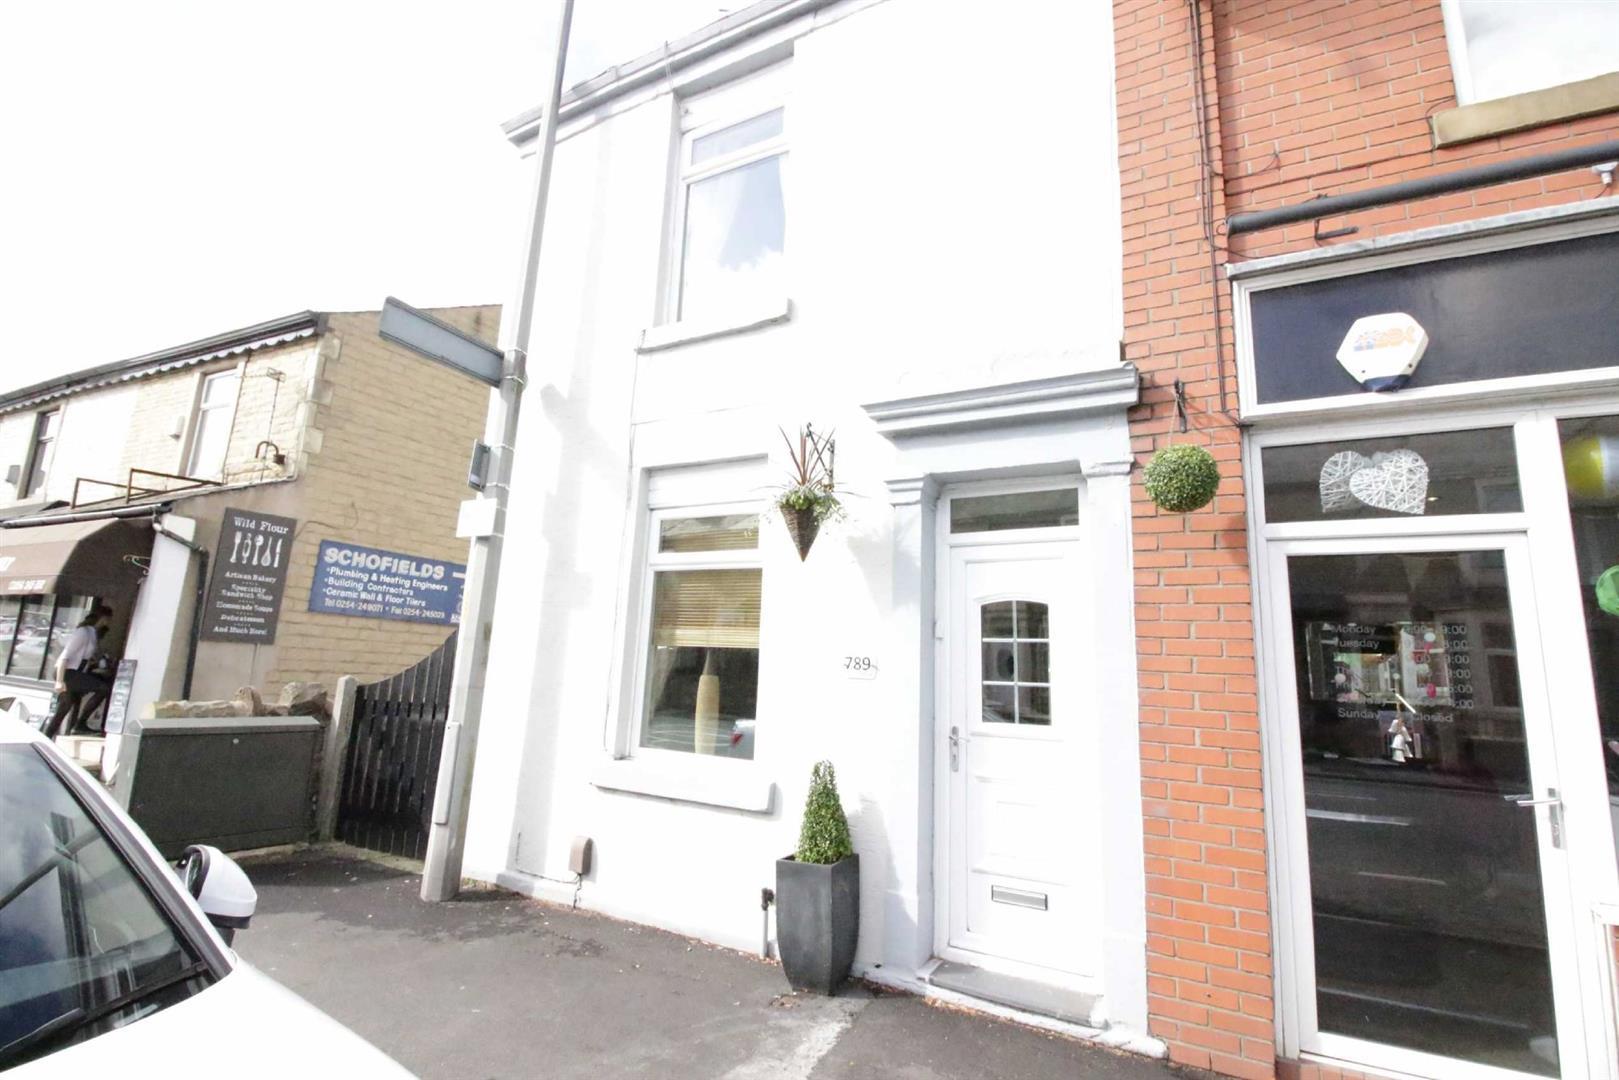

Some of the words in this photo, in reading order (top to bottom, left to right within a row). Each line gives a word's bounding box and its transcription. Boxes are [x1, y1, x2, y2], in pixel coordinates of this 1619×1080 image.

[234, 516, 256, 529] Wild
[260, 521, 289, 534] Flour
[324, 547, 445, 580] SCHOFIELDS
[224, 571, 252, 580] Artisan
[252, 574, 277, 584] Bakery
[330, 566, 369, 582] Plumbing
[371, 573, 378, 581] &
[380, 575, 411, 588] Heating
[412, 579, 448, 591] Engineers
[328, 577, 364, 591] Building
[367, 583, 414, 596] Contractors
[326, 587, 358, 598] Ceramic
[360, 591, 376, 601] Wall
[377, 594, 382, 602] &
[385, 594, 404, 604] Floor
[406, 597, 426, 607] Tilers
[1333, 625, 1377, 635] Monday
[1334, 639, 1379, 650] Tuesday
[844, 656, 871, 671] 789
[1338, 707, 1381, 720] Sunday
[1412, 711, 1453, 722] Closed
